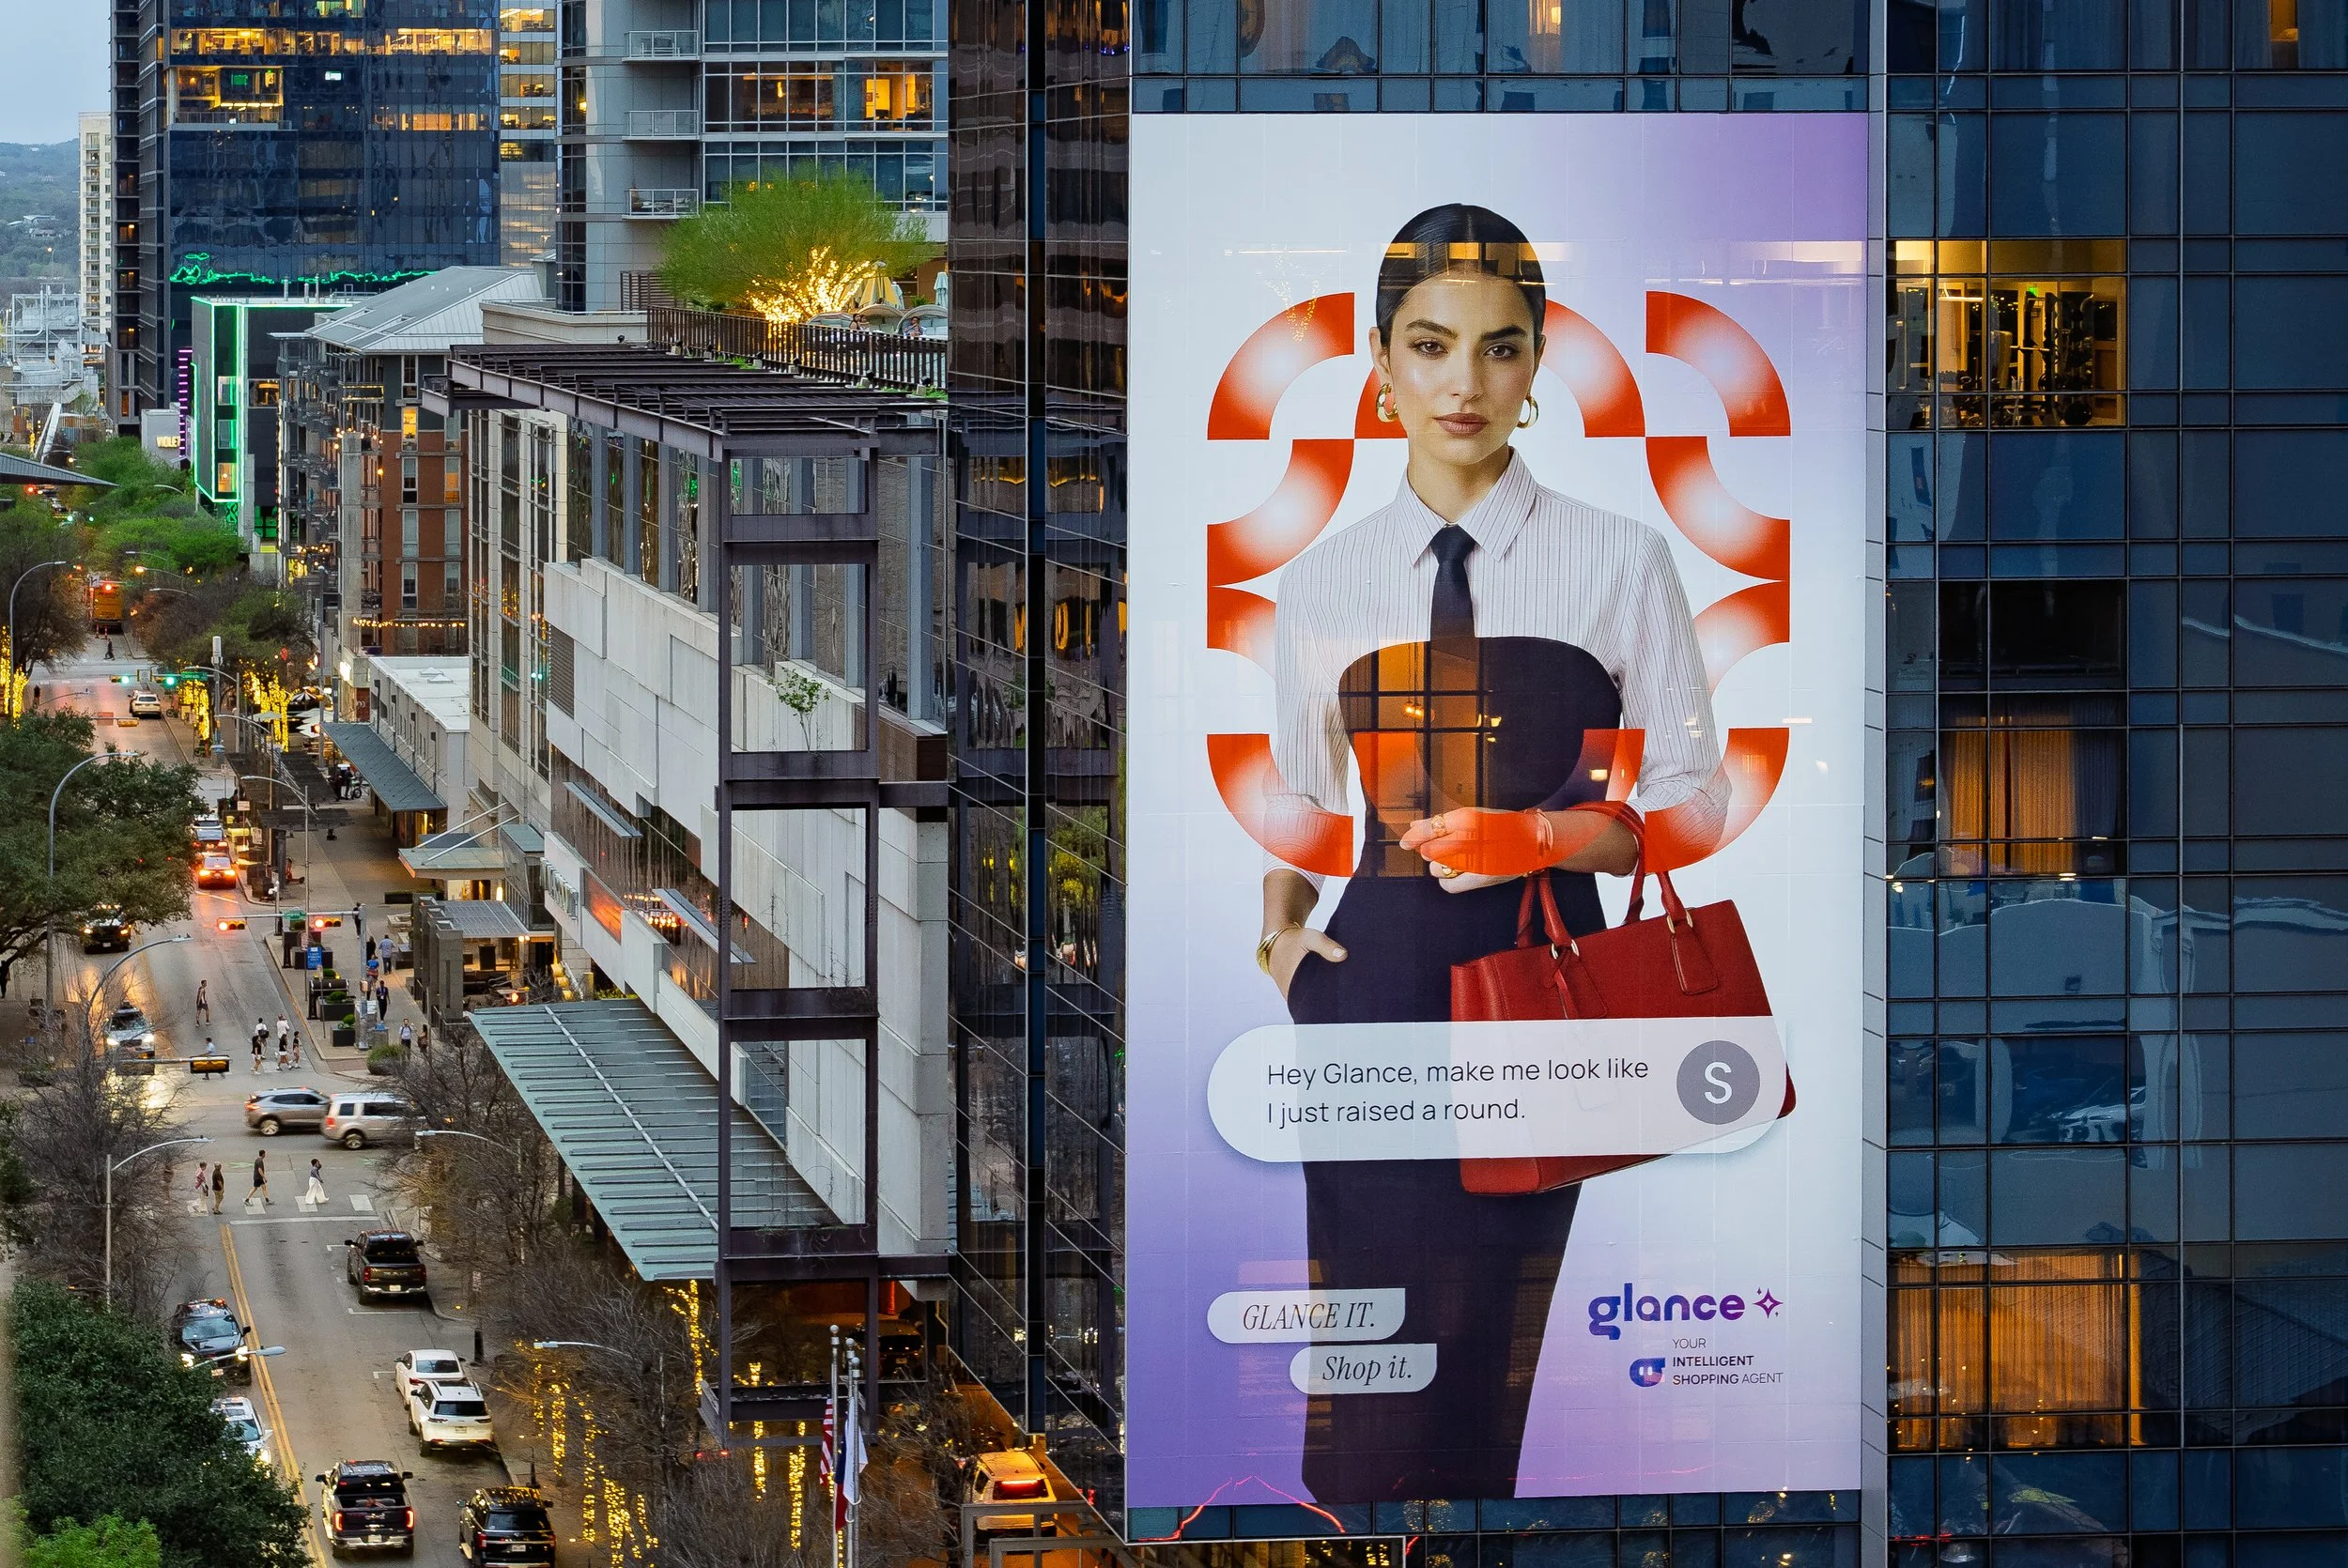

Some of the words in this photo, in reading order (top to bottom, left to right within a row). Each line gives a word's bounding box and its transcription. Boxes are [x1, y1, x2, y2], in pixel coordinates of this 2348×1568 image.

[1268, 1064, 1317, 1090] Hey
[1323, 1063, 1417, 1084] Glance,
[1427, 1061, 1494, 1083] make
[1503, 1064, 1540, 1081] me
[1549, 1058, 1600, 1080] look
[1608, 1057, 1648, 1079] like
[1704, 1061, 1733, 1104] S
[1268, 1102, 1272, 1123] I
[1279, 1102, 1329, 1130] just
[1336, 1099, 1414, 1122] raised
[1422, 1104, 1436, 1120] a
[1444, 1099, 1525, 1120] round.
[1243, 1302, 1340, 1330] GLANCE
[1344, 1301, 1375, 1329] IT.
[1587, 1283, 1746, 1340] glance
[1672, 1338, 1707, 1349] YOUR
[1321, 1356, 1381, 1386] Shop
[1388, 1355, 1412, 1379] it.
[1672, 1355, 1754, 1367] INTELLIGENT
[1672, 1374, 1739, 1385] SHOPPING
[1741, 1372, 1784, 1384] AGENT
